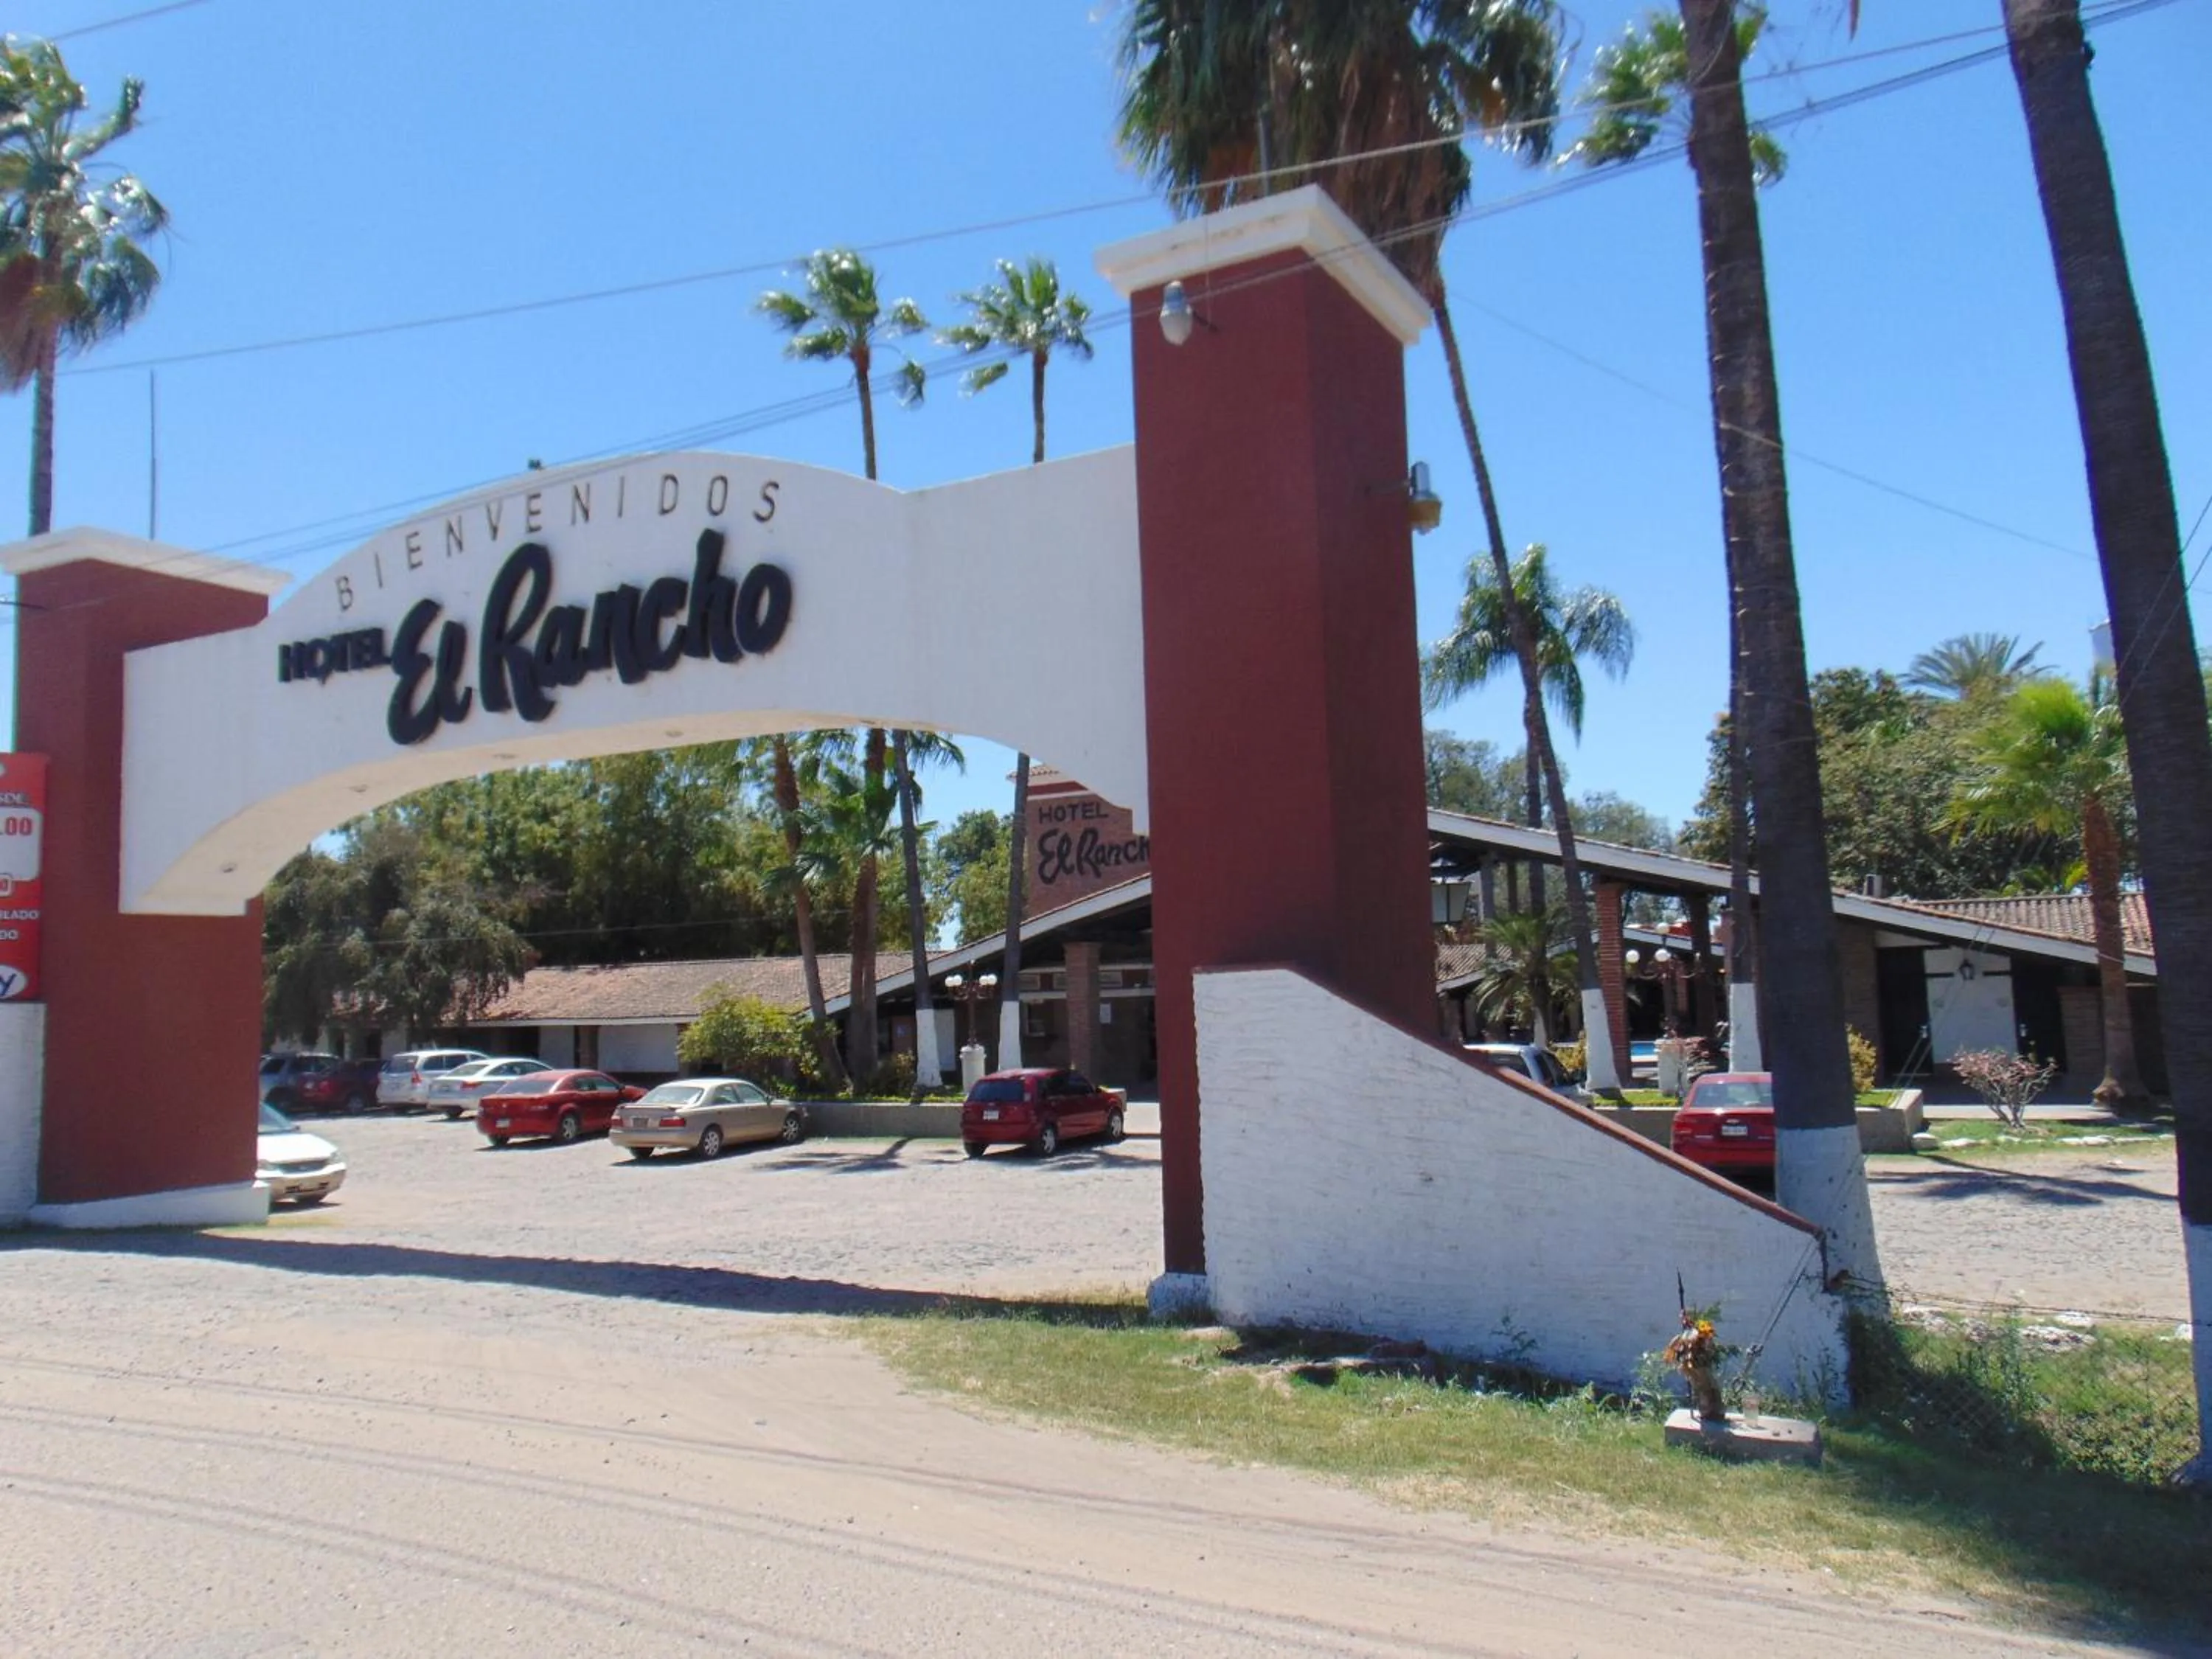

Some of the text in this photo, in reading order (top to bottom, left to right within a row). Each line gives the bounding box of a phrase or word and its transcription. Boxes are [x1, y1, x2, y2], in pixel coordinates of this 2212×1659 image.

[336, 473, 779, 611] BIENVENIDOS
[278, 528, 792, 745] HOTEL El Rancho
[1037, 828, 1074, 885] El
[1038, 802, 1108, 824] HOTEL
